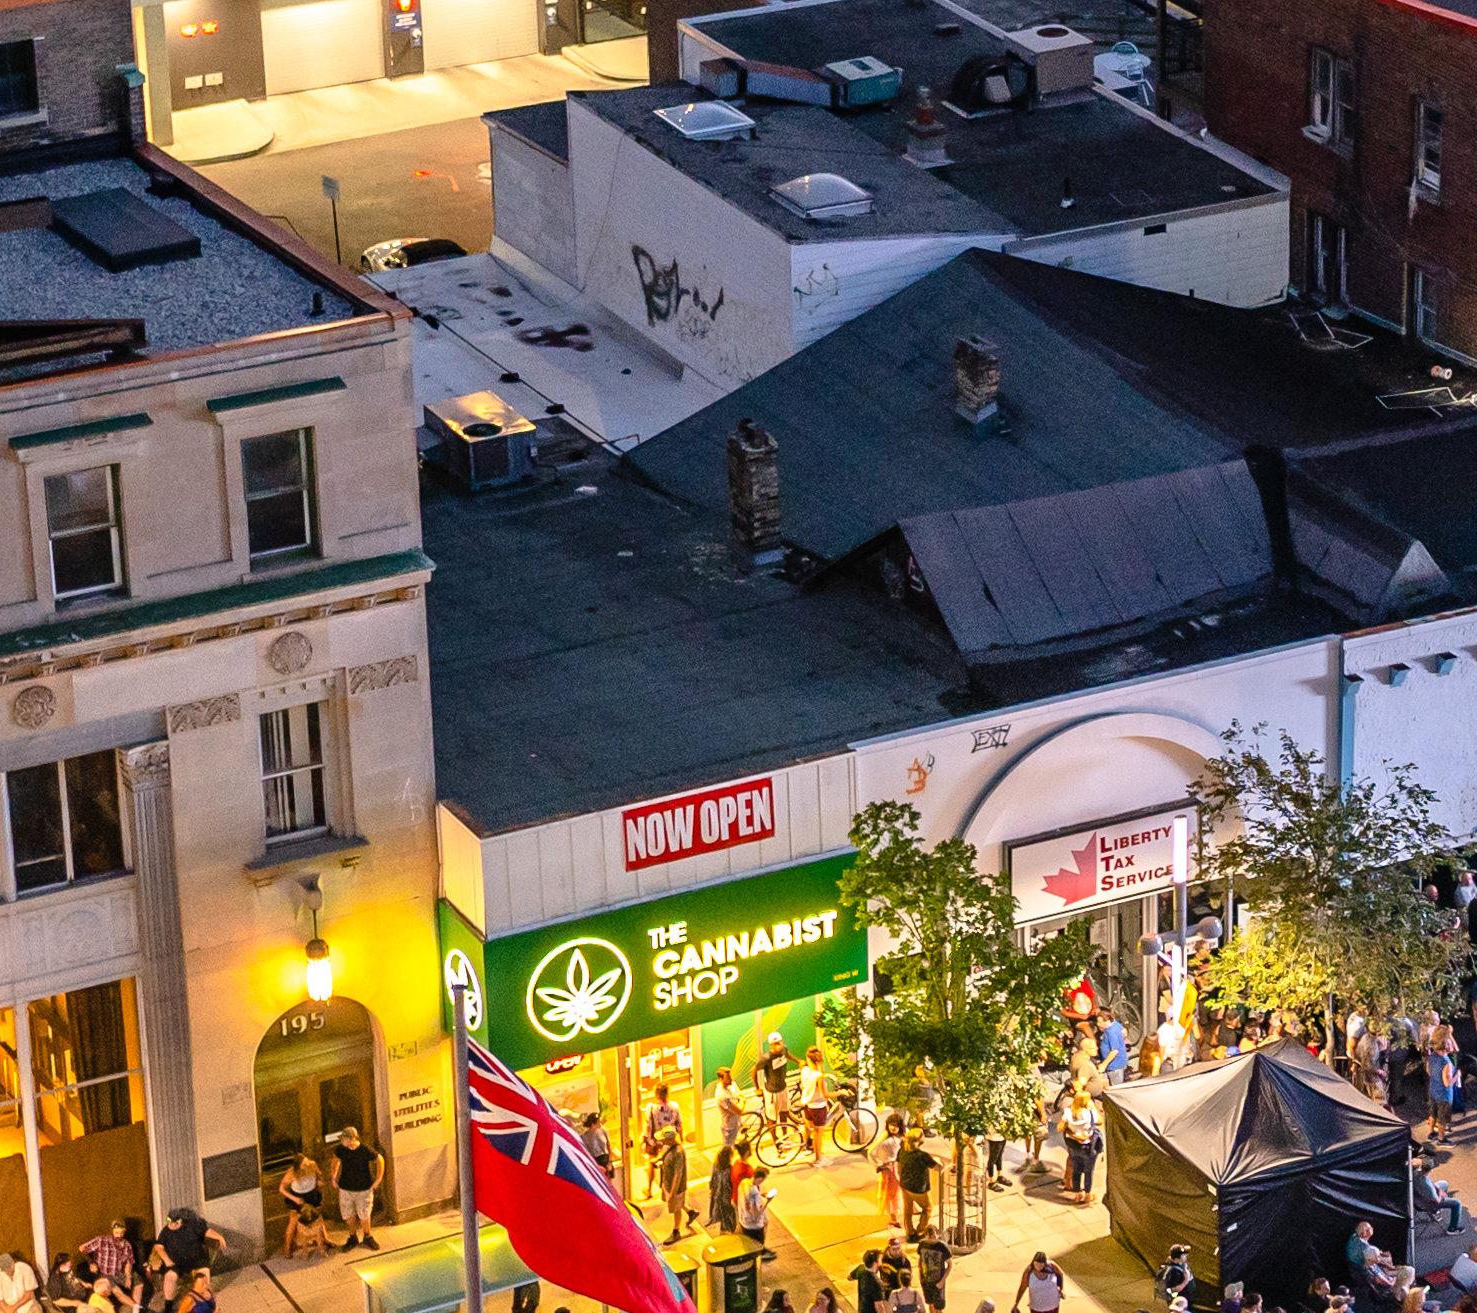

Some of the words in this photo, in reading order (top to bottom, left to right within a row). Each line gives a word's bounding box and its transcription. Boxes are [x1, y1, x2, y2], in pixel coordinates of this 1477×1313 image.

[625, 803, 695, 863] NOW
[699, 786, 773, 845] OPEN
[1100, 825, 1172, 854] LIBERTY
[1100, 854, 1135, 872] TAX
[1100, 864, 1173, 892] SERVICE
[647, 921, 689, 950] THE
[652, 909, 838, 979] CANNABIST
[652, 965, 740, 1012] SHOP
[280, 1011, 325, 1037] 195
[399, 1085, 432, 1102] PUBLIC
[393, 1099, 441, 1119] UTILITIES
[393, 1114, 443, 1134] BUILDING
